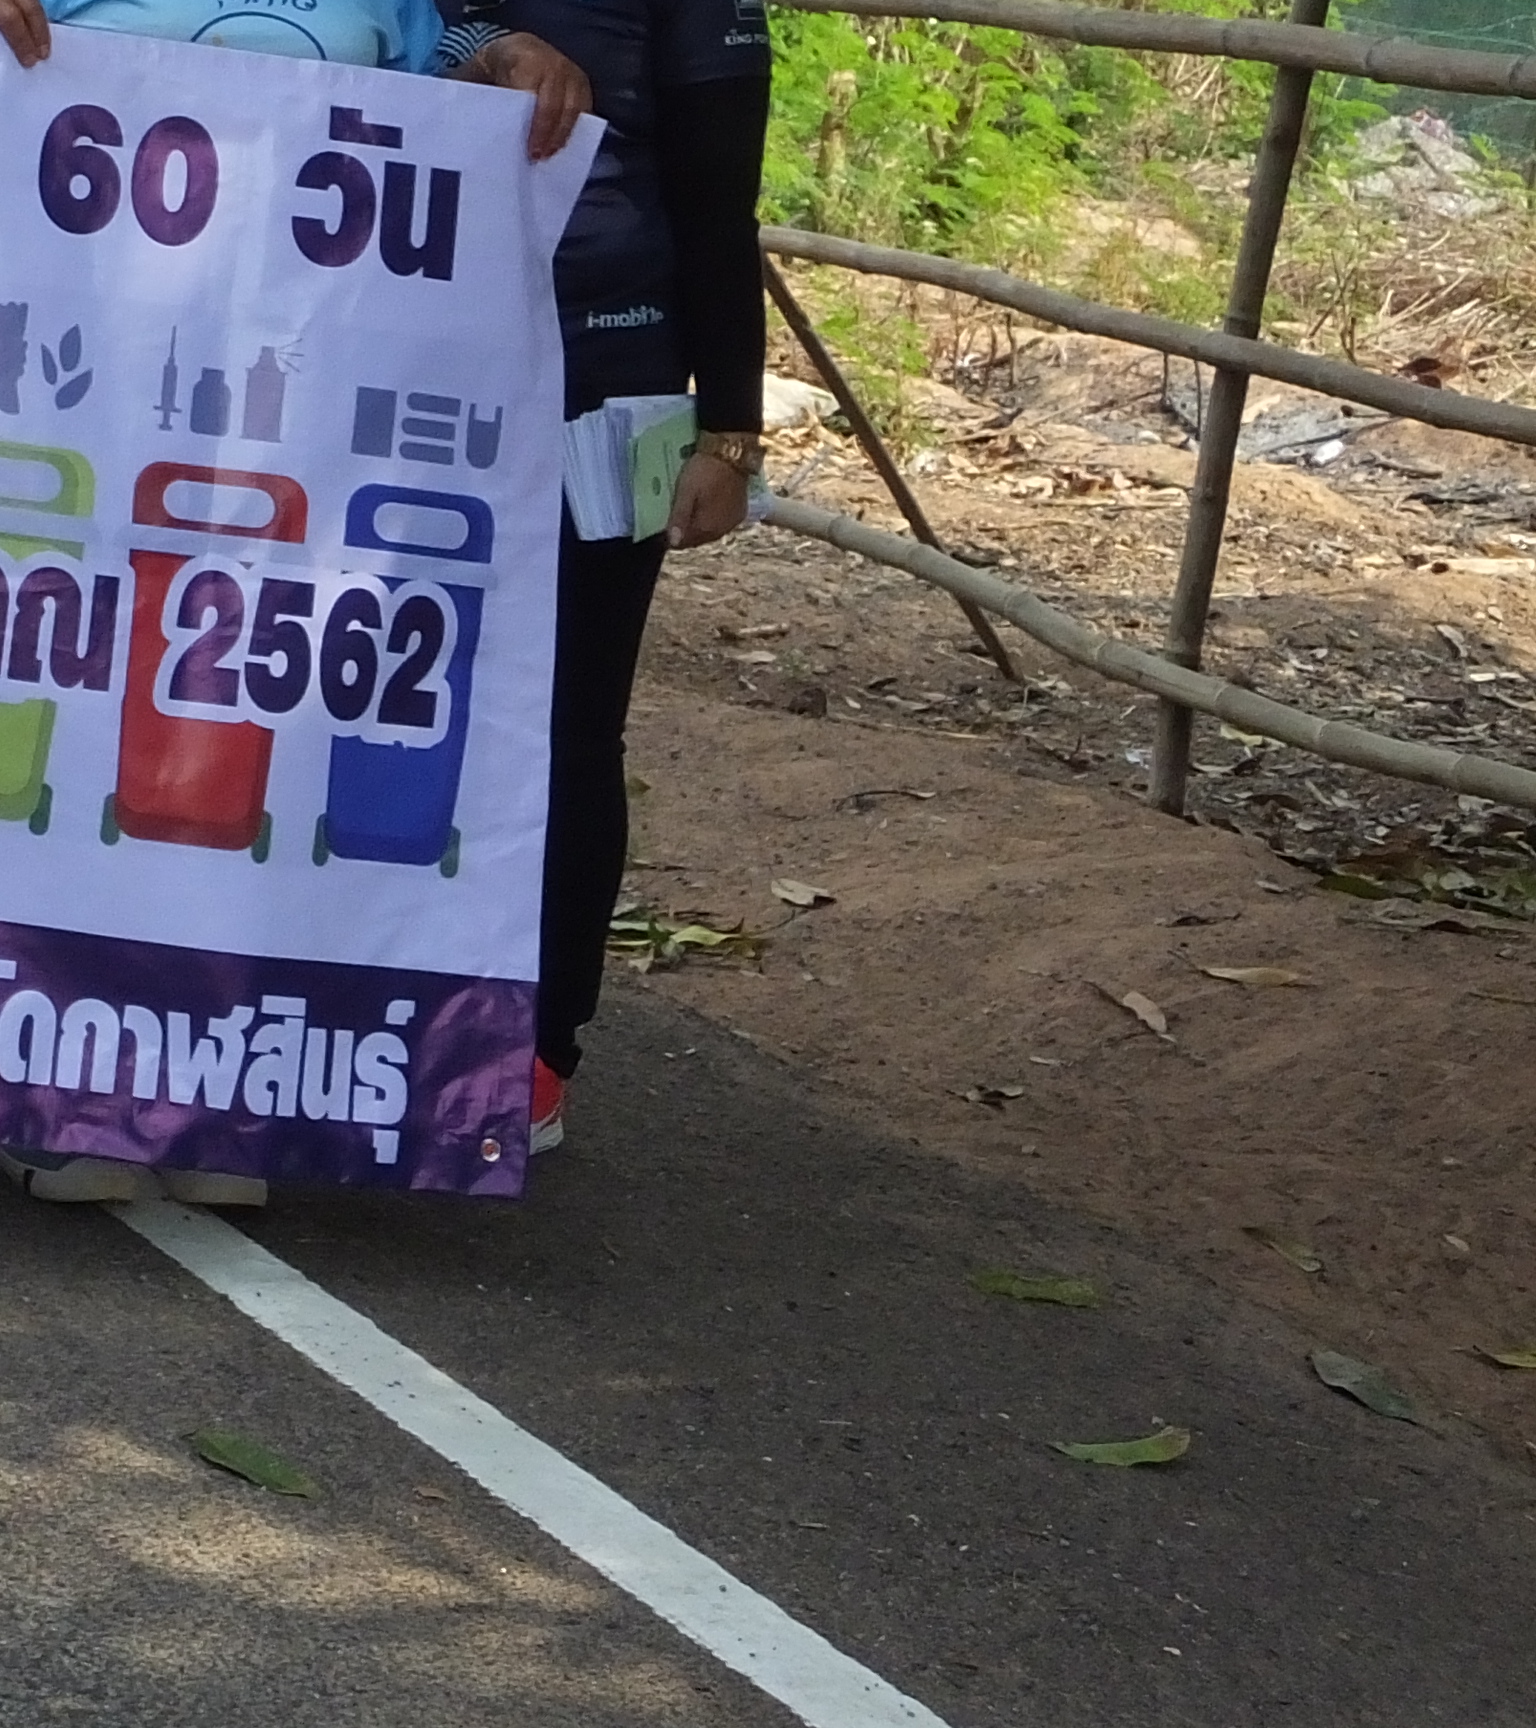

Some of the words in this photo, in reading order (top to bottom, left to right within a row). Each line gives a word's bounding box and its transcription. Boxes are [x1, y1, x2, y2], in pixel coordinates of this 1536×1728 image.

[38, 103, 220, 247] 60
[290, 104, 463, 281] วัน
[586, 304, 665, 329] i-mobile
[168, 568, 447, 730] 2562
